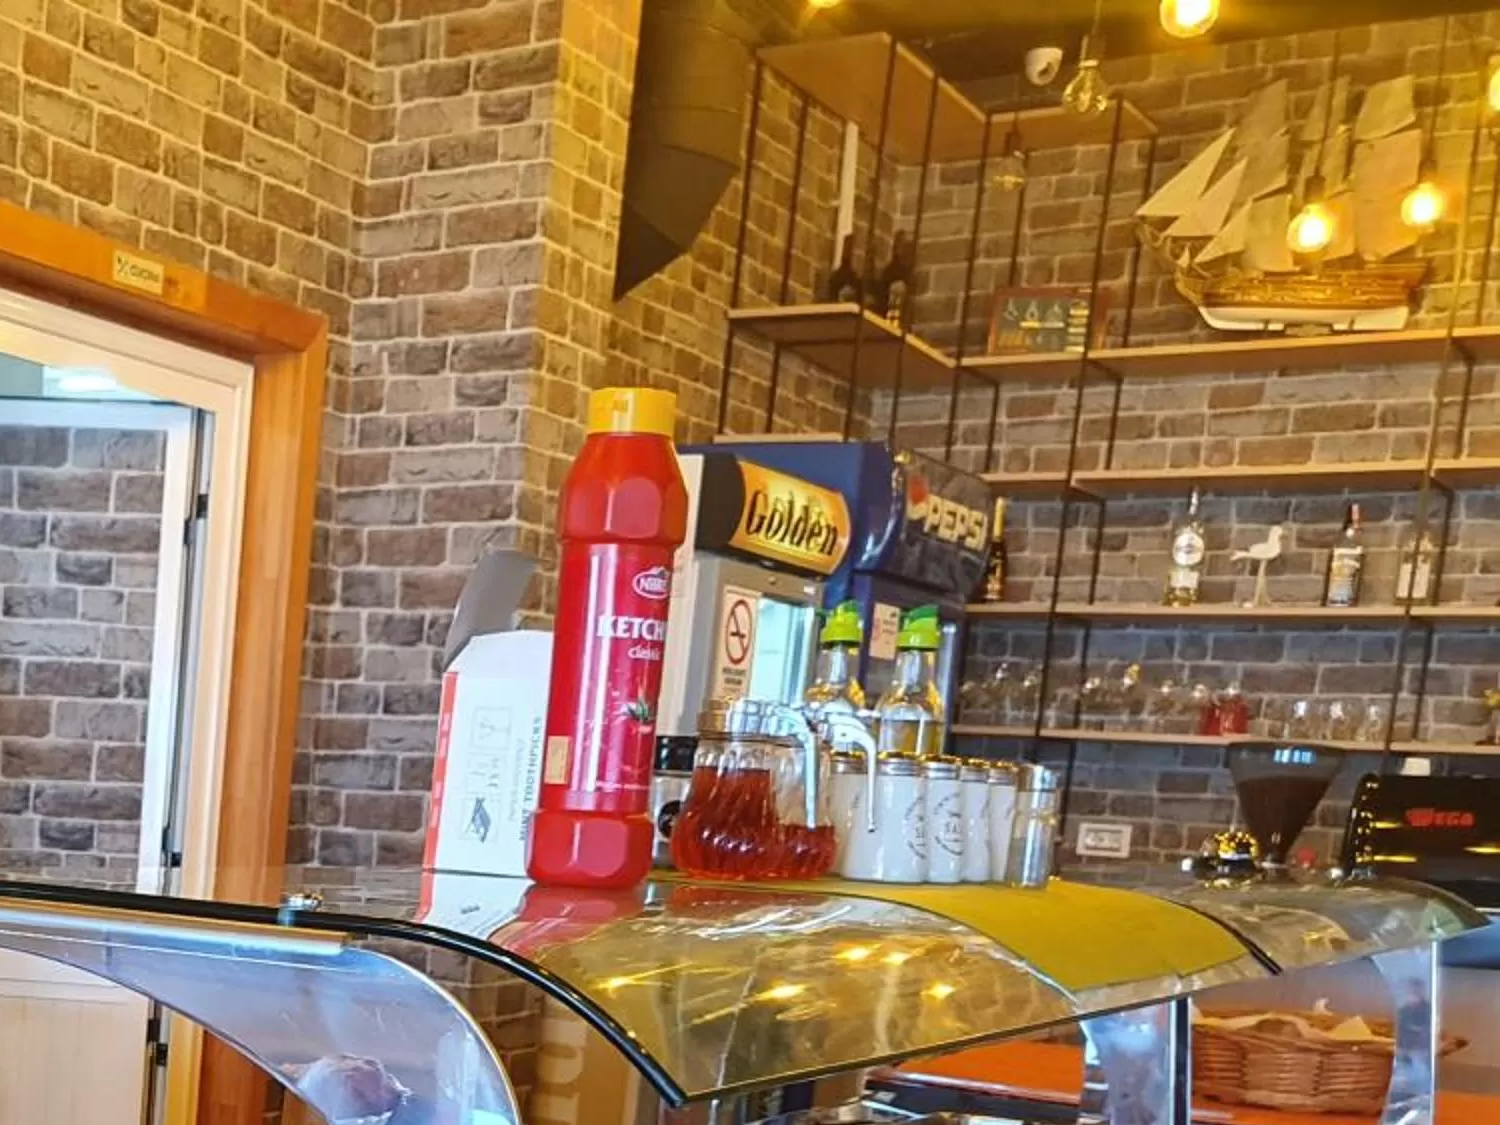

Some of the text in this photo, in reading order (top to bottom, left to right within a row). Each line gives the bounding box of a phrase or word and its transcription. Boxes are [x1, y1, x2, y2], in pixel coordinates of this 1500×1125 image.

[745, 488, 838, 556] Golden
[923, 495, 988, 550] PEPSI
[597, 615, 667, 640] KETCH
